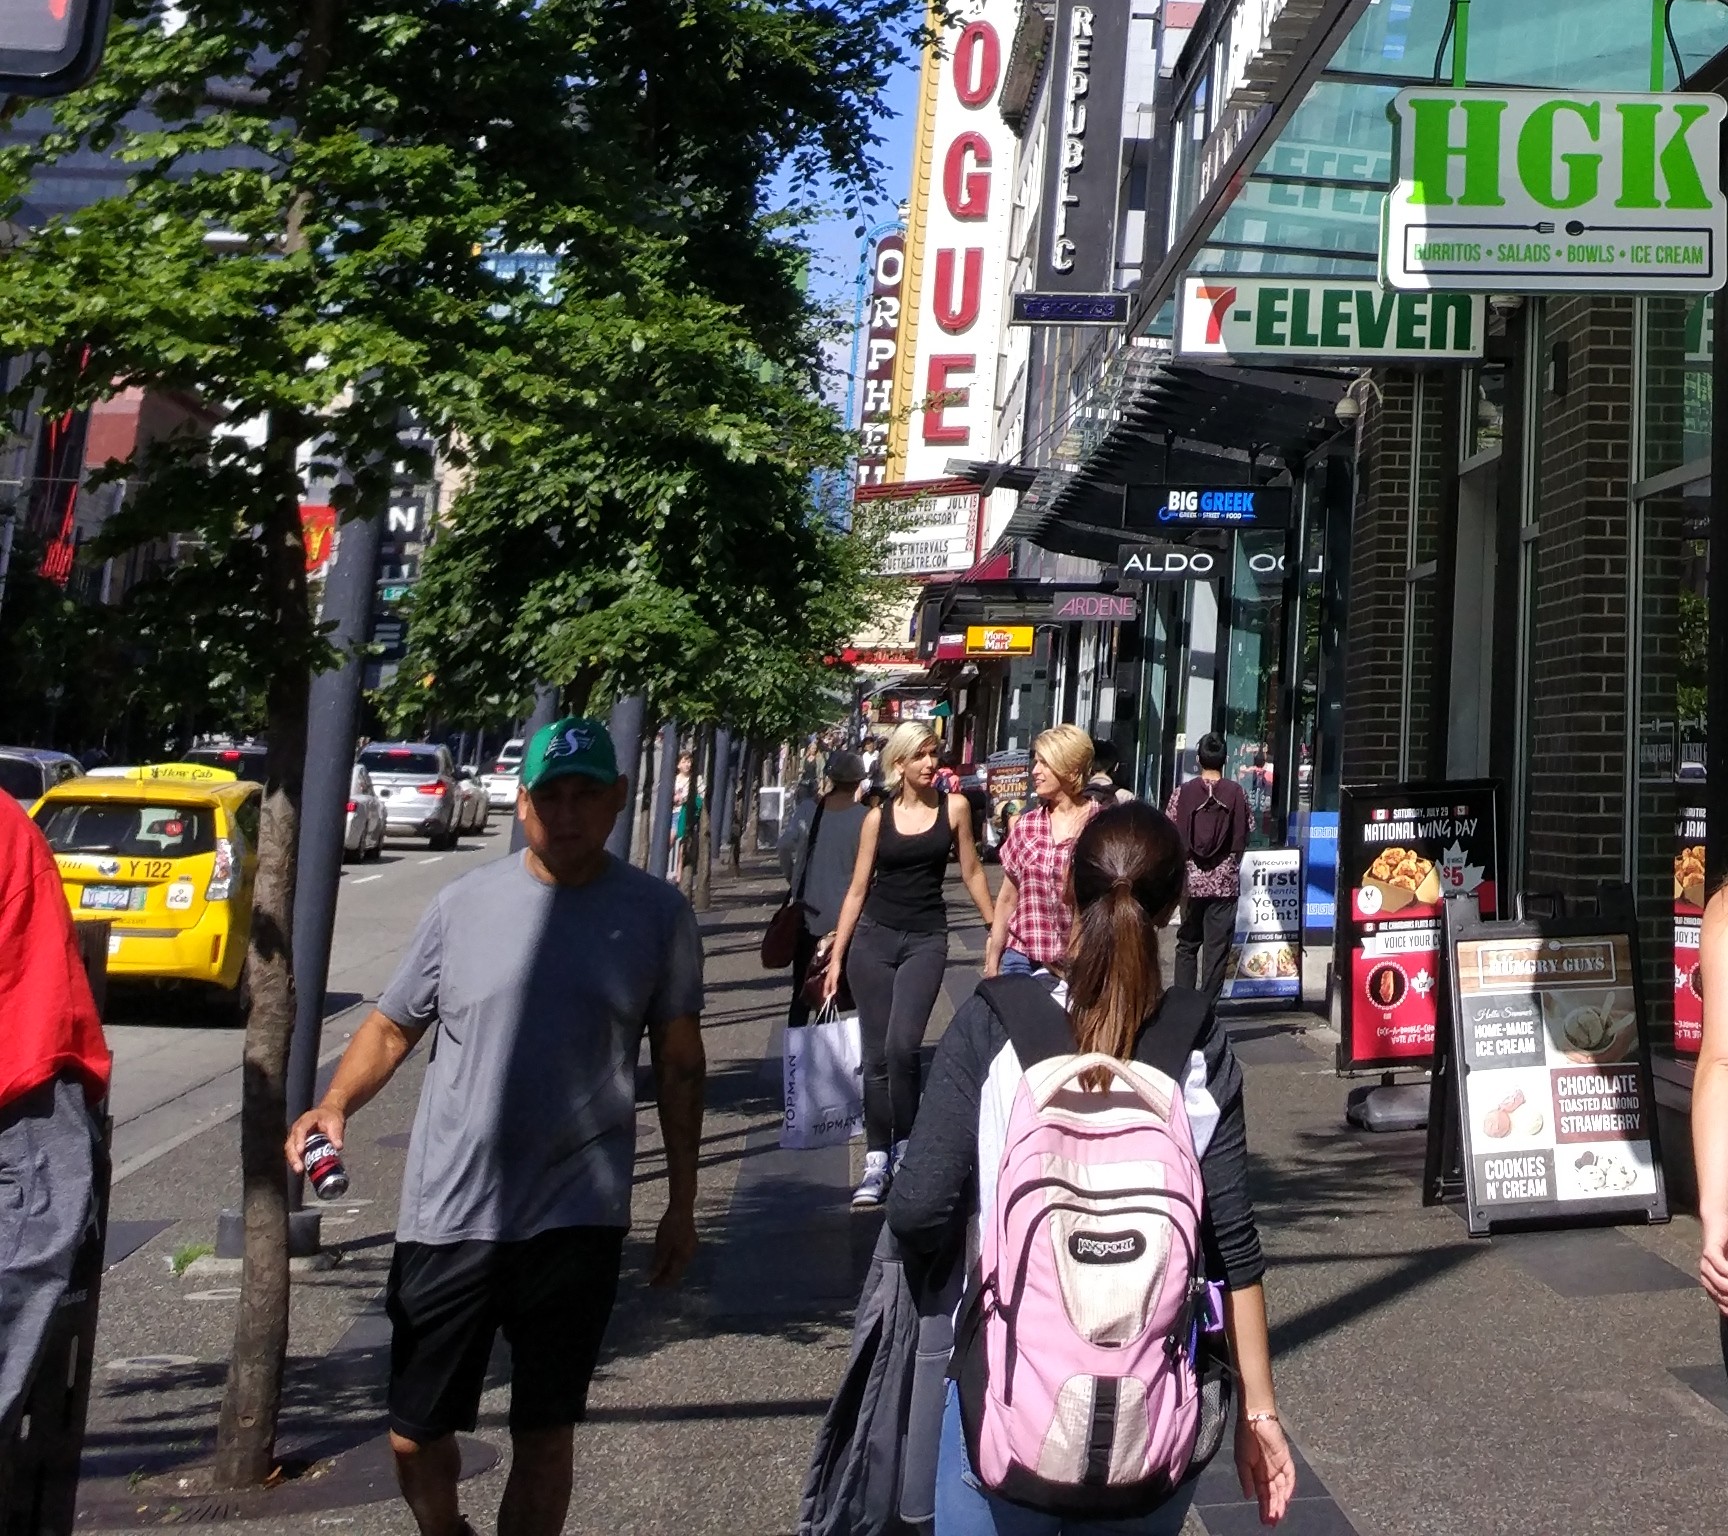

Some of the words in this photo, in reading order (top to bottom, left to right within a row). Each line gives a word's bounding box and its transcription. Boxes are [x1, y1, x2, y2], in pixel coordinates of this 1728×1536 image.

[1052, 5, 1094, 274] REPUBLIC
[1405, 98, 1713, 211] HGK
[1413, 242, 1481, 263] BURRITOS
[1496, 243, 1552, 264] SALADS
[1566, 244, 1616, 265] BOWLS
[1630, 245, 1653, 265] ICE
[1655, 245, 1704, 266] CREAM
[946, 496, 969, 510] JULY
[1168, 490, 1198, 511] BIG
[1201, 491, 1255, 512] GREEK
[908, 540, 949, 556] INTERVALS
[1123, 553, 1214, 572] ALDO
[1057, 597, 1134, 617] ARDENE
[983, 629, 1013, 644] Money
[984, 639, 1010, 650] Mart
[191, 769, 214, 779] Cab
[1364, 821, 1416, 842] NATIONAL
[1418, 818, 1452, 839] WING
[1455, 817, 1478, 837] DAY
[130, 860, 140, 877] Y
[145, 861, 172, 878] 122
[1252, 868, 1297, 886] first
[1443, 866, 1464, 886] $5
[1252, 897, 1298, 908] Yeero
[1254, 909, 1299, 924] joint!
[1384, 935, 1406, 949] VOICE
[1408, 934, 1431, 948] YOUR
[1562, 955, 1605, 972] GUYS
[1474, 1021, 1535, 1038] HOME-MADE
[1475, 1039, 1495, 1058] ICE
[1495, 1037, 1536, 1056] CREAM
[1557, 1074, 1638, 1096] CHOCOLATE
[1558, 1097, 1600, 1113] TOASTED
[1601, 1096, 1640, 1111] ALMOND
[1560, 1114, 1641, 1134] STRAWBERRY
[1484, 1156, 1546, 1180] COOKIES
[1502, 1178, 1548, 1199] CREAM
